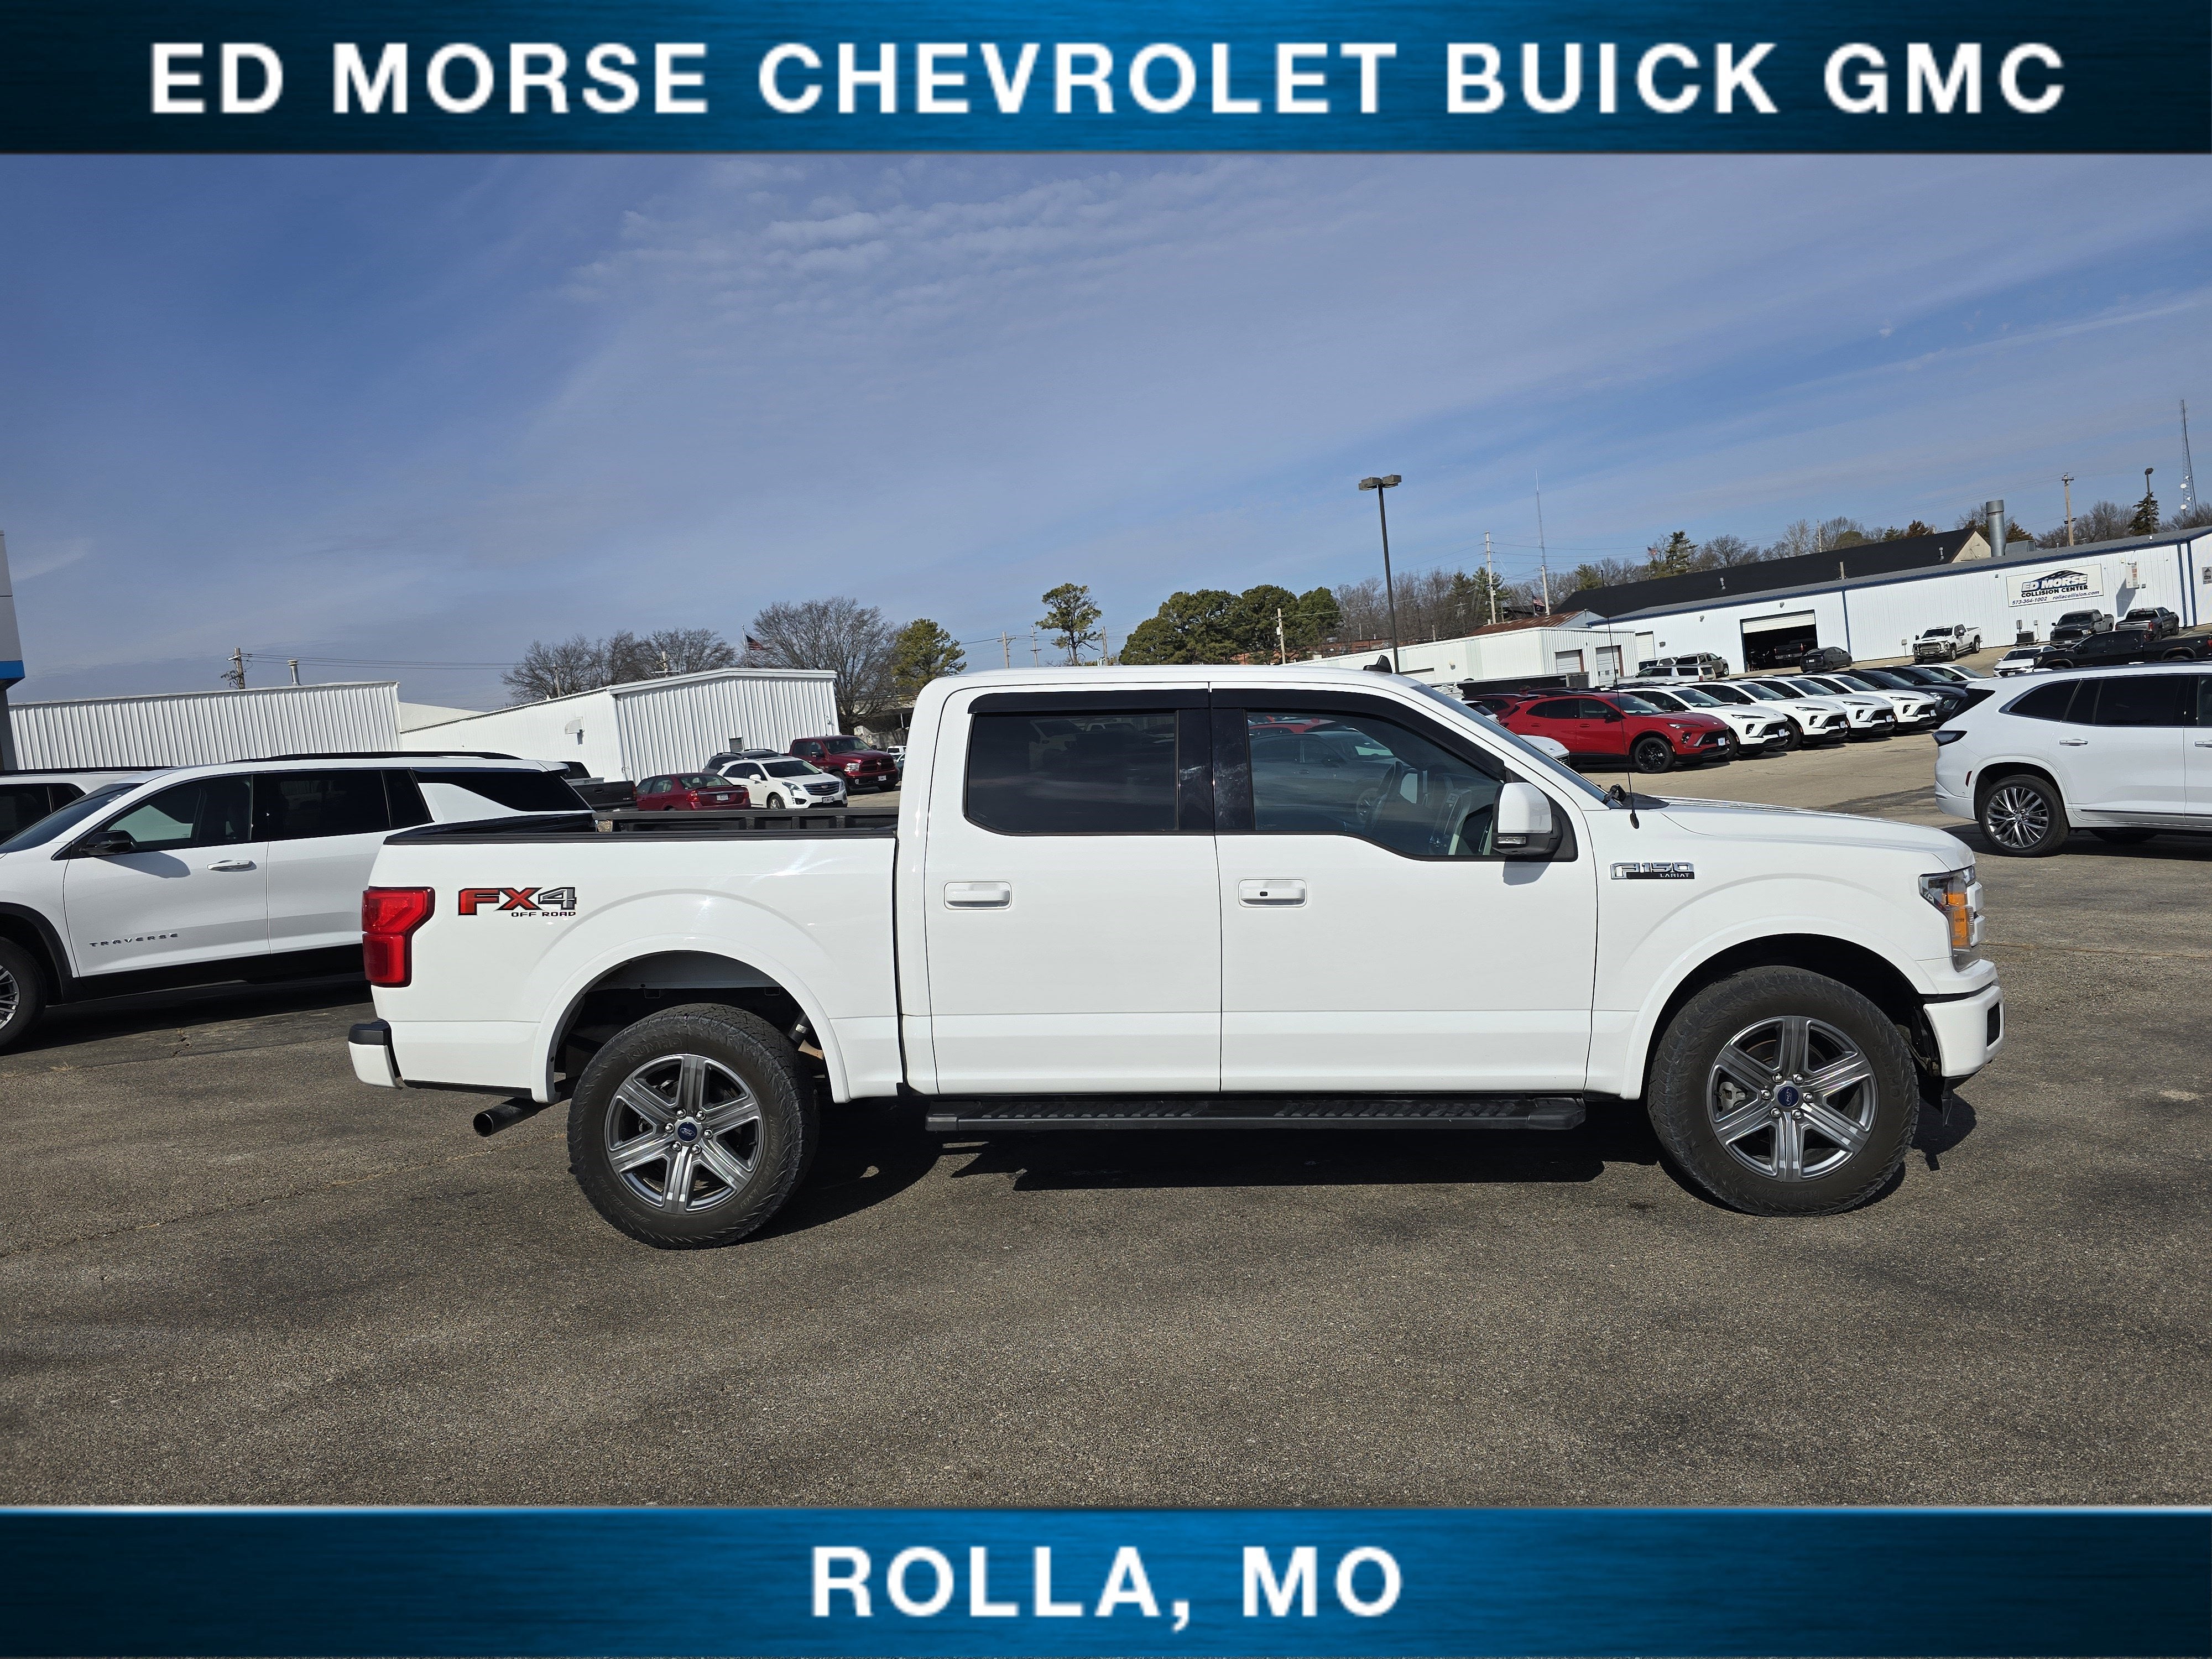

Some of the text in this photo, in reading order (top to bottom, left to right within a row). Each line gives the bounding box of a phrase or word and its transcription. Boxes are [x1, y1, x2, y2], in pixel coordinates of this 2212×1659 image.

[2022, 574, 2088, 592] ED MORSE
[2021, 588, 2059, 598] COLLISION
[2053, 591, 2100, 601] rollacollision.com
[458, 886, 577, 916] FX4
[89, 933, 179, 947] TRAVERSE
